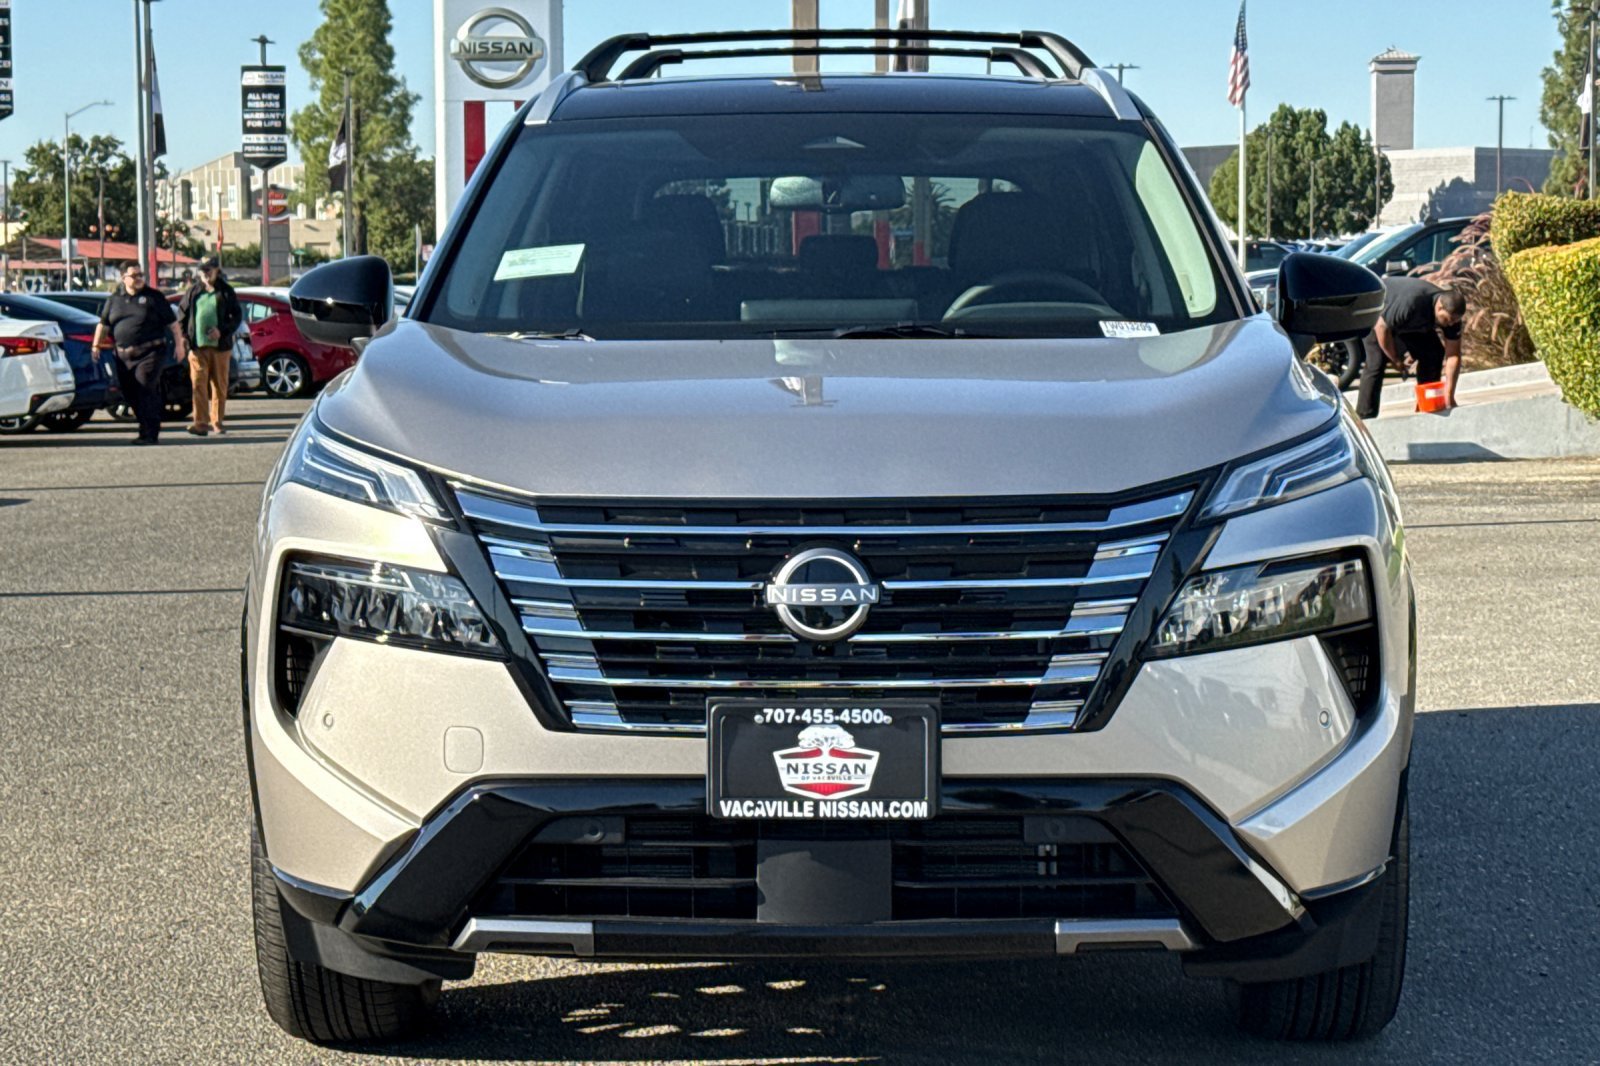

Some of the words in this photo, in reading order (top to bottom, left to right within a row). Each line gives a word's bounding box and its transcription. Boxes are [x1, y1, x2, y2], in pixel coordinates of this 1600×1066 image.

[458, 41, 534, 55] NISSAN
[771, 587, 876, 602] NISSAN
[763, 708, 884, 724] 707-455-4500
[786, 762, 867, 775] NISSAN
[720, 800, 815, 818] VACAVILLE
[819, 800, 928, 819] NISSAN.COM
